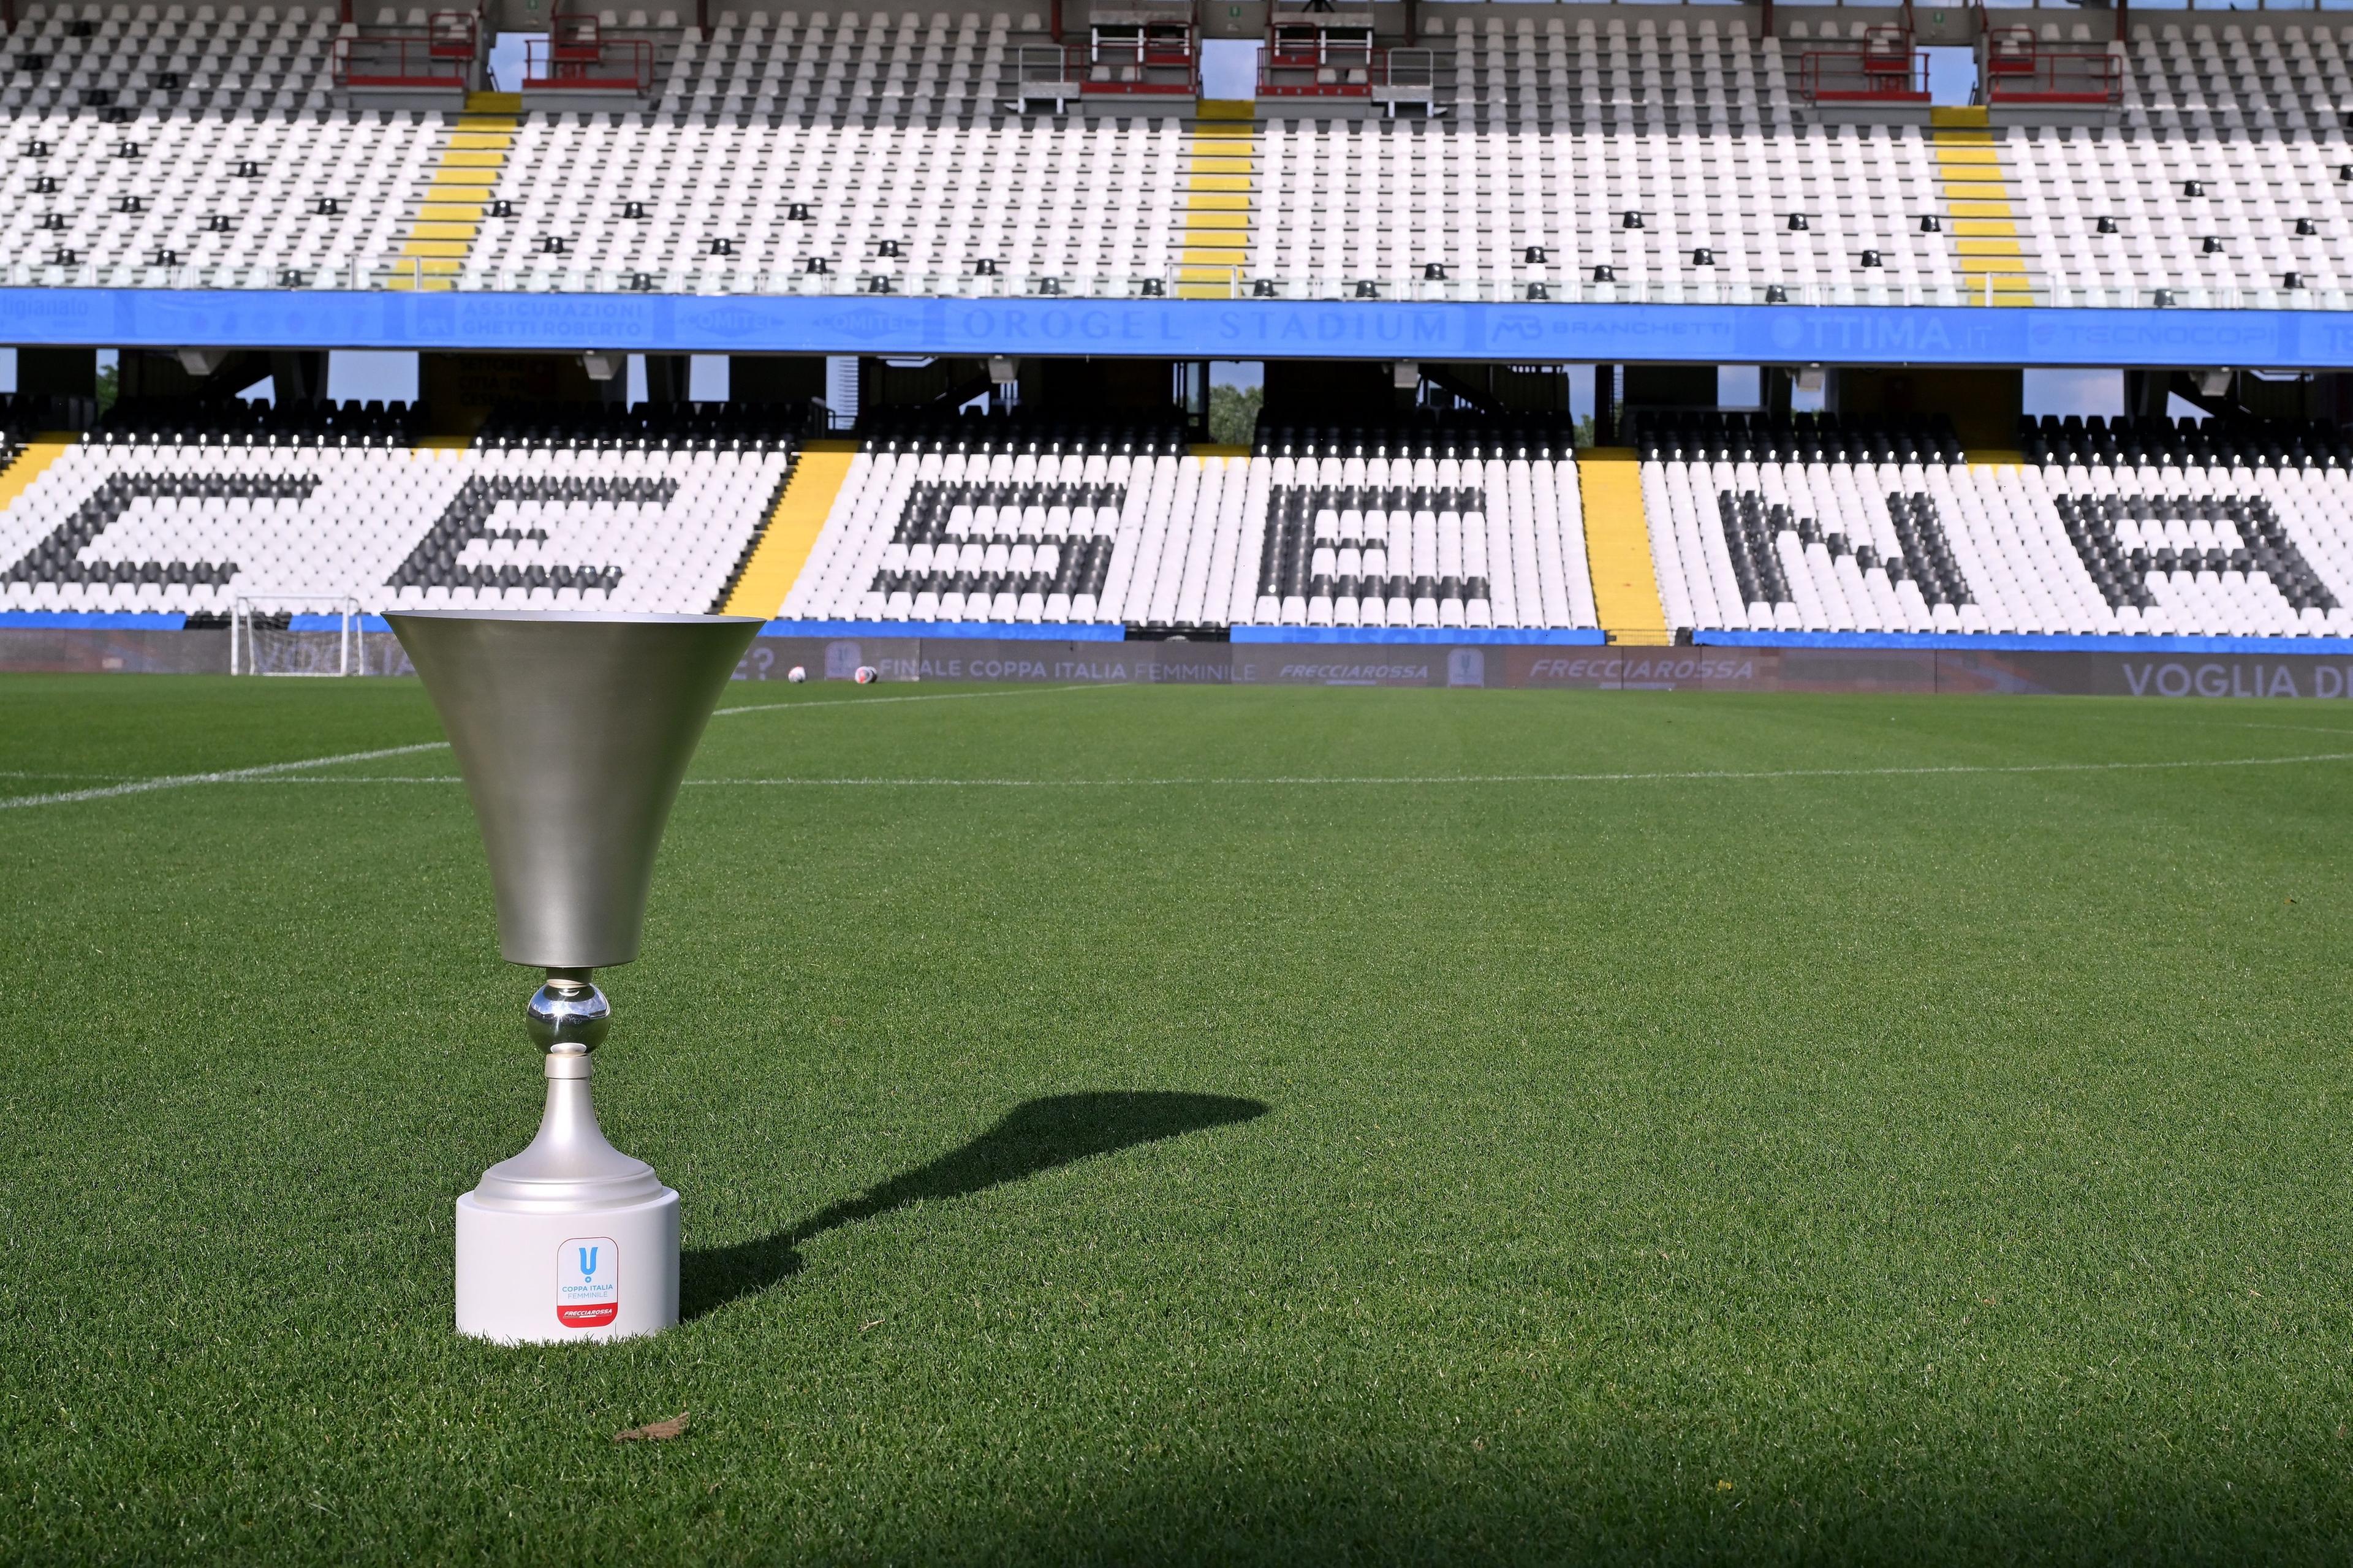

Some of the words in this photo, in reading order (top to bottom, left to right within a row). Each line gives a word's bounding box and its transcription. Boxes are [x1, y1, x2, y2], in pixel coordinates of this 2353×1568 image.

[463, 300, 643, 318] ASSICURAZIONI
[463, 320, 537, 336] GHETTI
[544, 321, 642, 336] ROBERTO
[963, 309, 1182, 340] OROGEL
[1219, 311, 1447, 341] STADIUM
[1553, 322, 1730, 335] BRANCHETTI
[0, 471, 2340, 610] CESENA
[880, 659, 961, 675] FINALE
[970, 661, 1047, 677] COPPA
[1055, 662, 1126, 679] ITALIA
[1135, 663, 1256, 681] FEMMINILE
[1280, 664, 1428, 678] FRECCIAROSSA
[1529, 659, 1753, 680] FRECCIAROSSA
[2122, 663, 2300, 698] VOGLIA
